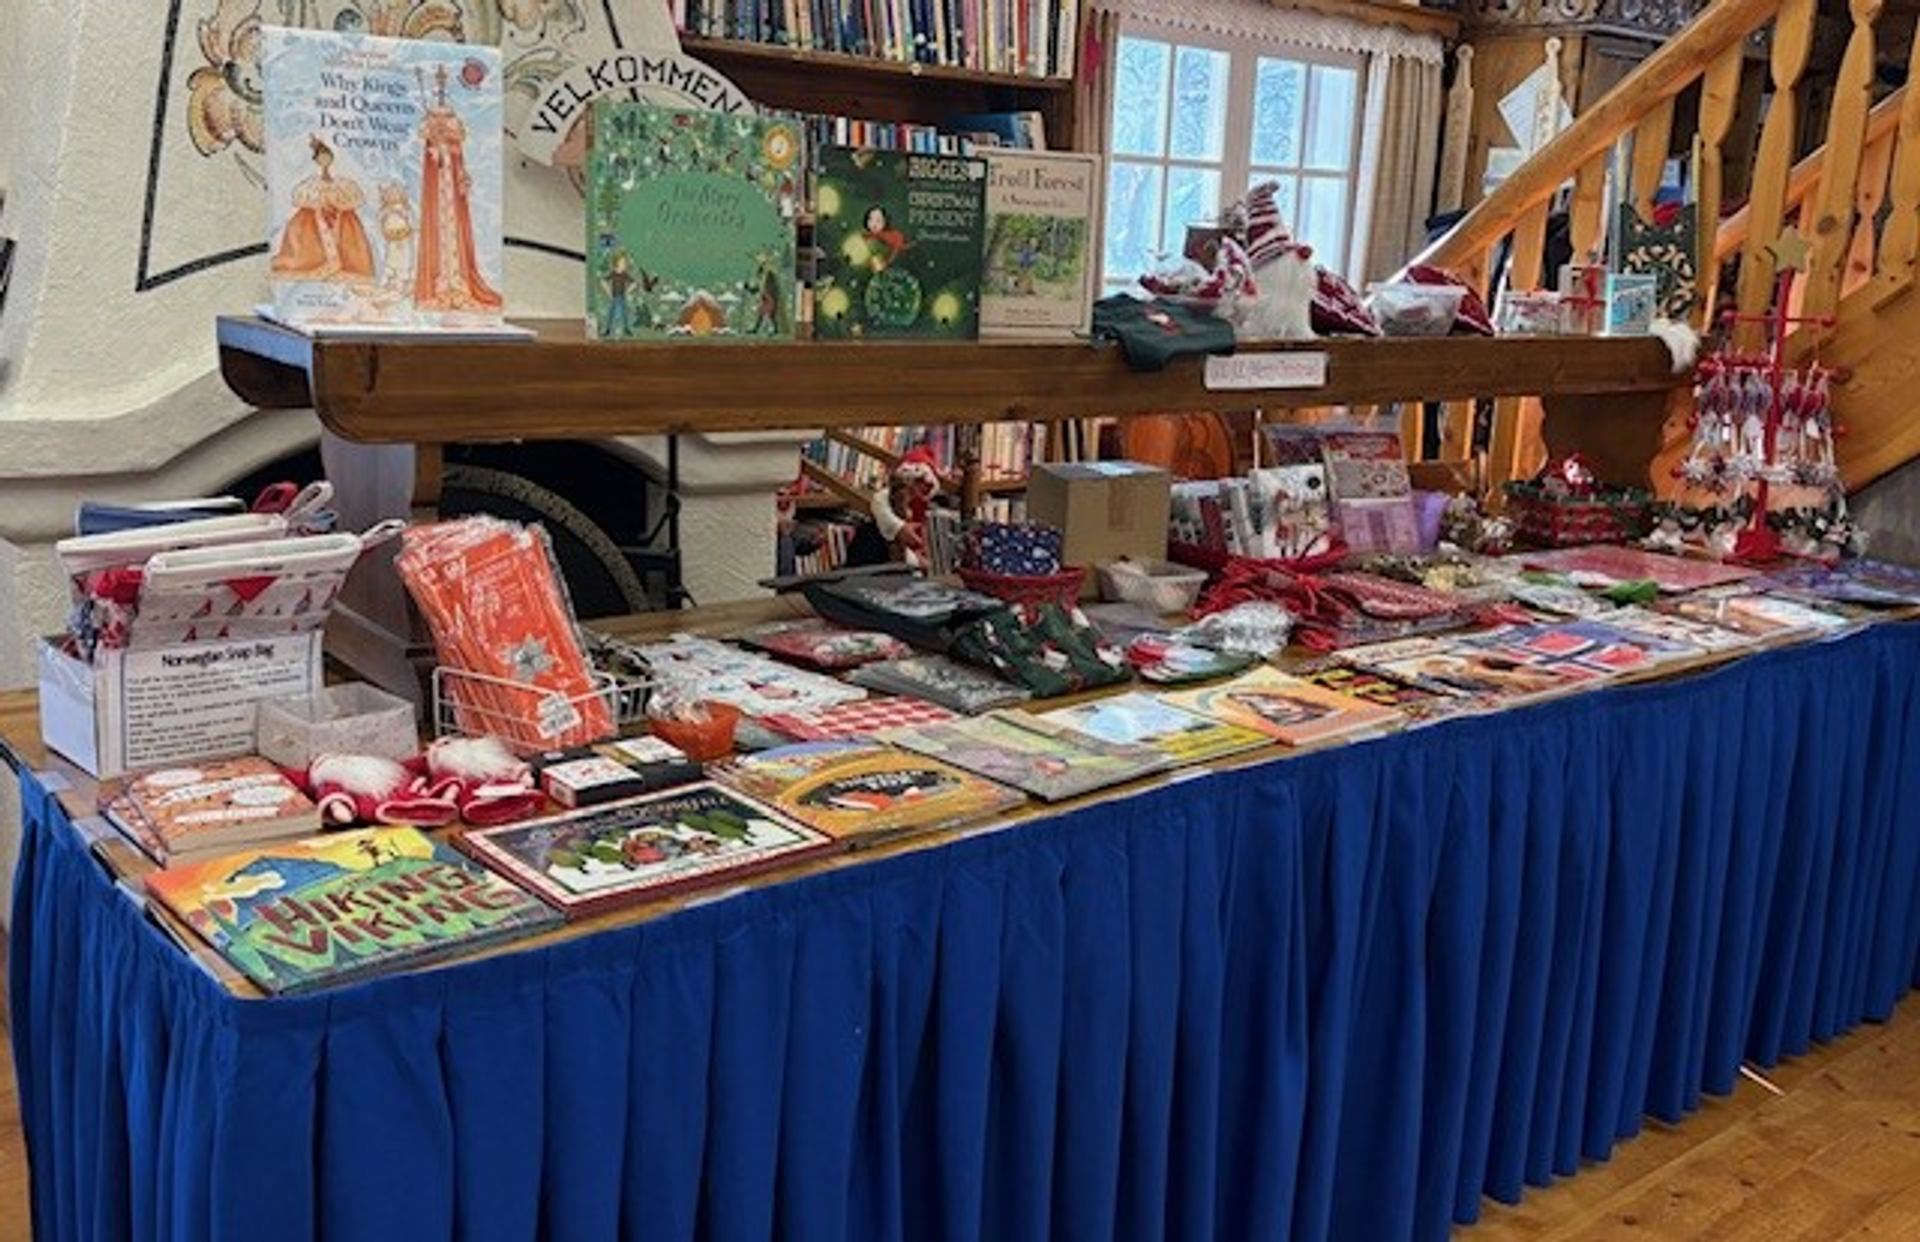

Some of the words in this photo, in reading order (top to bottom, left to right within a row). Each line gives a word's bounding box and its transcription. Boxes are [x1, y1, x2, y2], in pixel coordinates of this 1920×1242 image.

[320, 71, 357, 94] Why
[362, 76, 407, 98] Kings
[531, 55, 743, 134] VELKOMMEN
[314, 93, 346, 110] and
[350, 97, 415, 116] Queens
[1034, 167, 1084, 191] Forest
[161, 650, 223, 669] Norwegian
[225, 646, 252, 661] Snap
[254, 865, 475, 934] HIKING
[262, 884, 524, 955] VIKING
